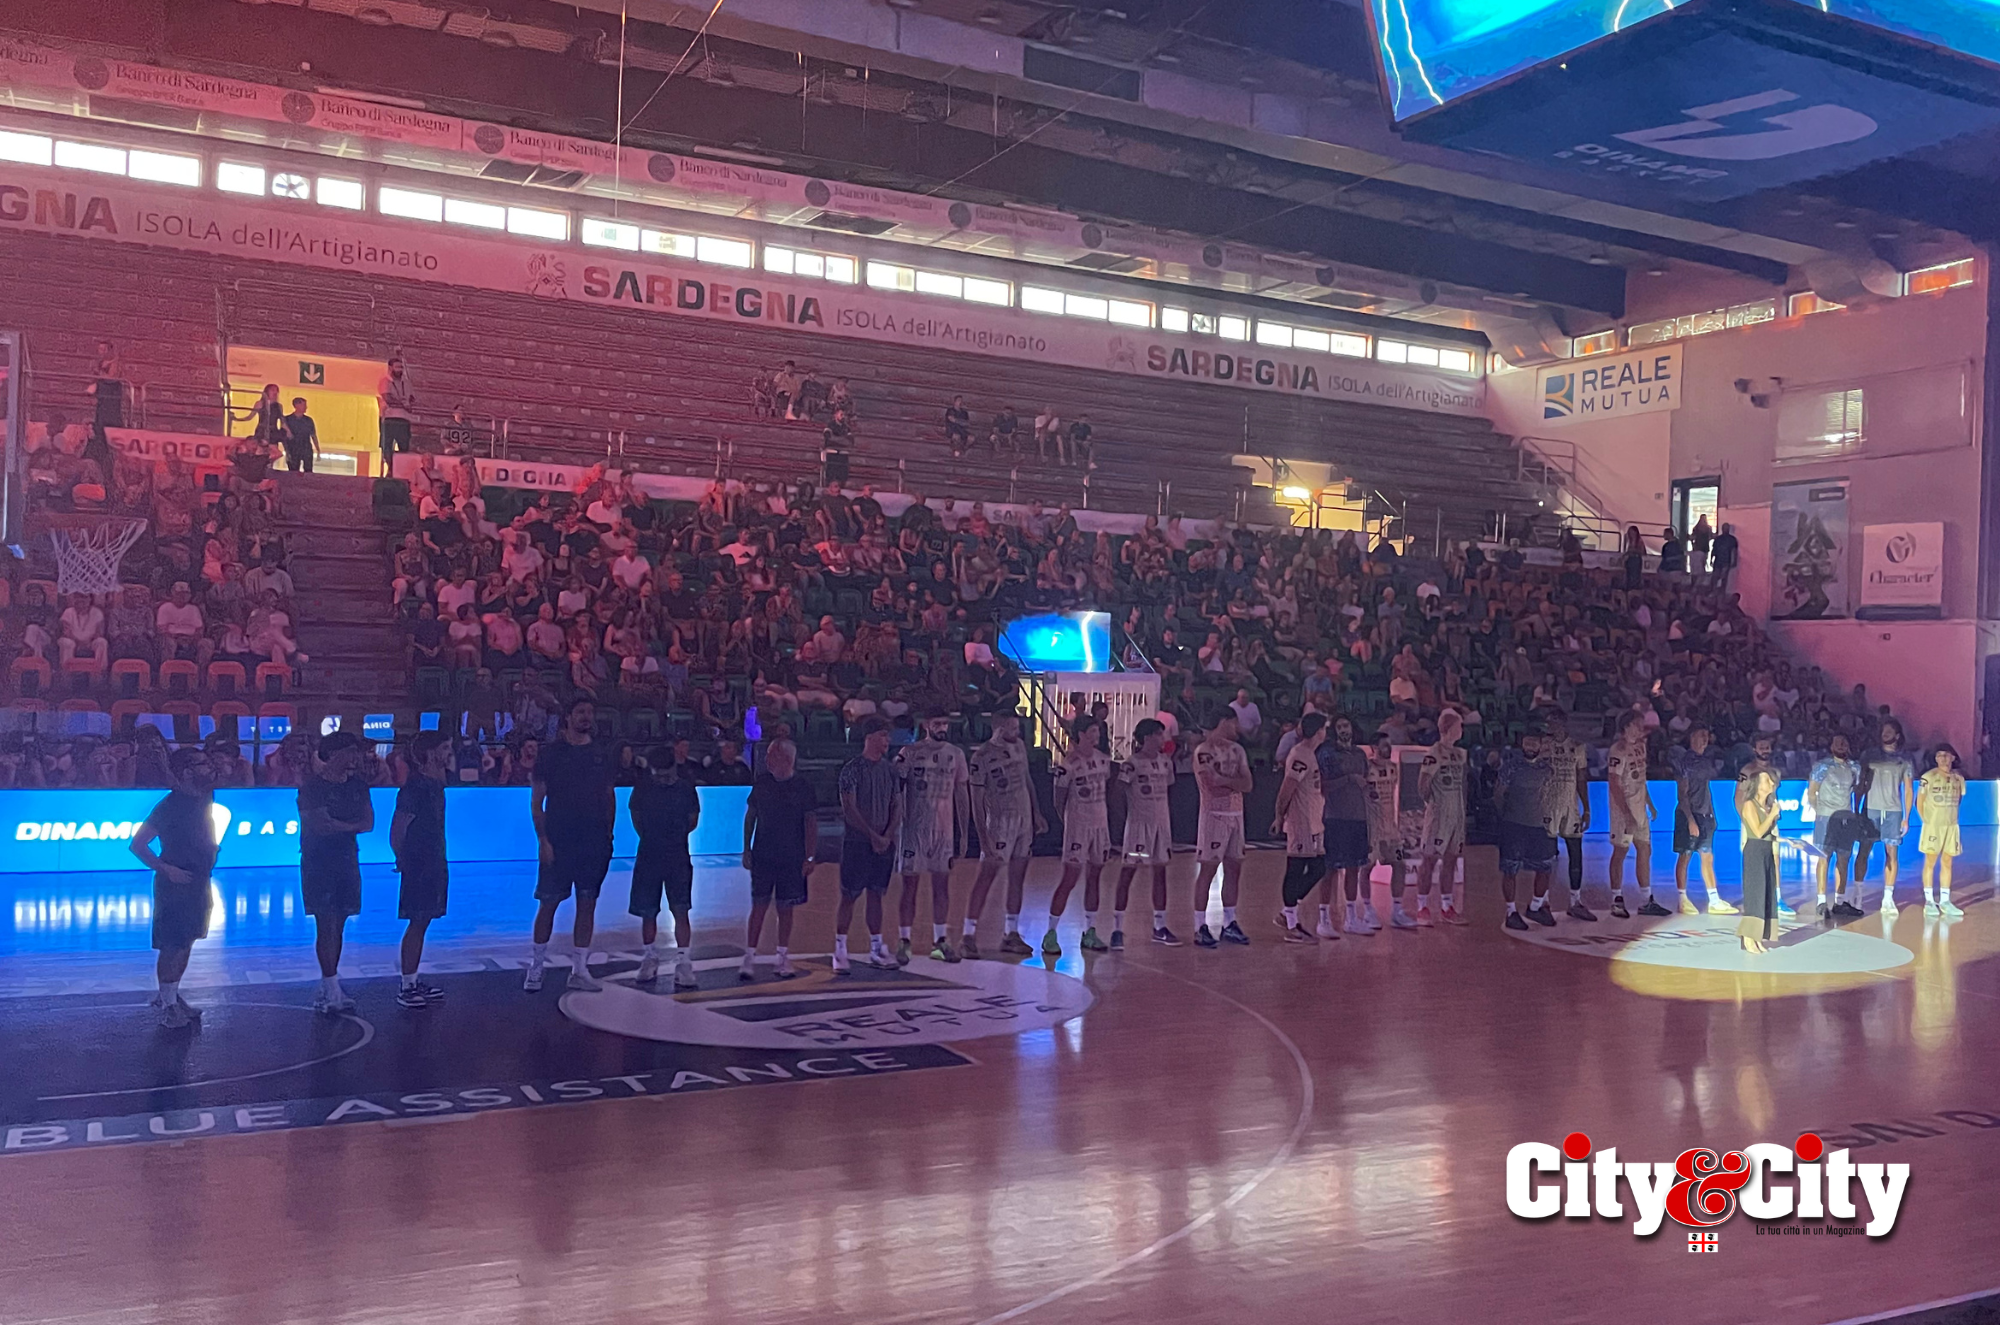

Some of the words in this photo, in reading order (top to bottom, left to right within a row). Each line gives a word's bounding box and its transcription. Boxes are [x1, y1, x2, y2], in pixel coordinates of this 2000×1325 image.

[184, 76, 258, 100] Sardegna
[321, 99, 366, 119] Banco
[368, 109, 382, 122] di
[384, 110, 451, 134] Sardegna
[136, 210, 222, 242] ISOLA
[232, 224, 439, 271] dell'Artigianato
[583, 266, 825, 328] SARDEGNA
[836, 308, 896, 333] ISOLA
[902, 316, 1047, 353] dell'Artigianato
[1147, 345, 1320, 392] SARDEGNA
[1328, 374, 1372, 396] ISOLA
[1376, 382, 1484, 410] dell'Artigianato
[1581, 355, 1672, 393] REALE
[1580, 385, 1671, 415] MUTUA
[451, 429, 472, 445] 92
[237, 820, 299, 836] BAS
[772, 995, 1038, 1037] REALE
[4, 1105, 291, 1150] BLUE
[326, 1052, 909, 1123] ASSISTANCE
